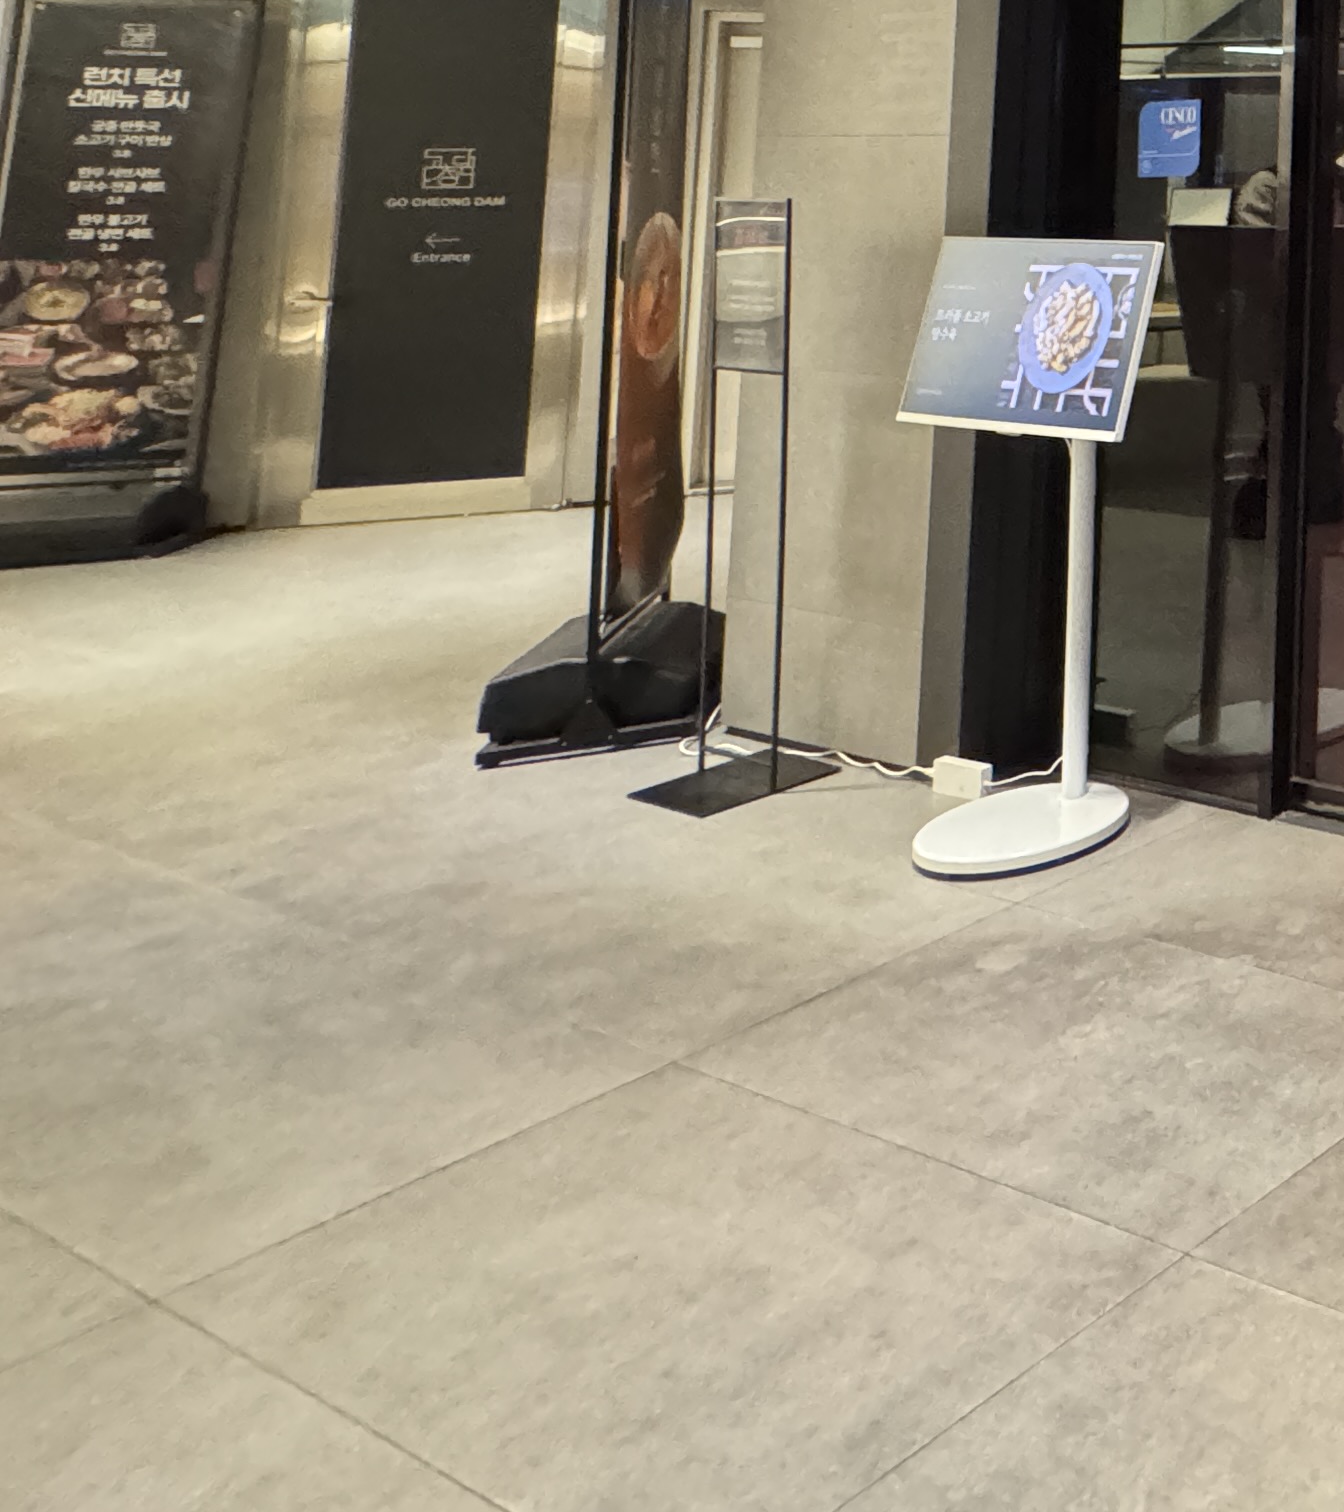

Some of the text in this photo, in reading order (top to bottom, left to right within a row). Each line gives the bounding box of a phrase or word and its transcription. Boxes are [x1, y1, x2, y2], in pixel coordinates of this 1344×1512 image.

[83, 66, 183, 88] 런치 특선
[67, 88, 190, 109] 신메뉴 출시
[386, 197, 409, 208] GO
[411, 196, 471, 208] CHEONG
[410, 252, 471, 264] Entrance
